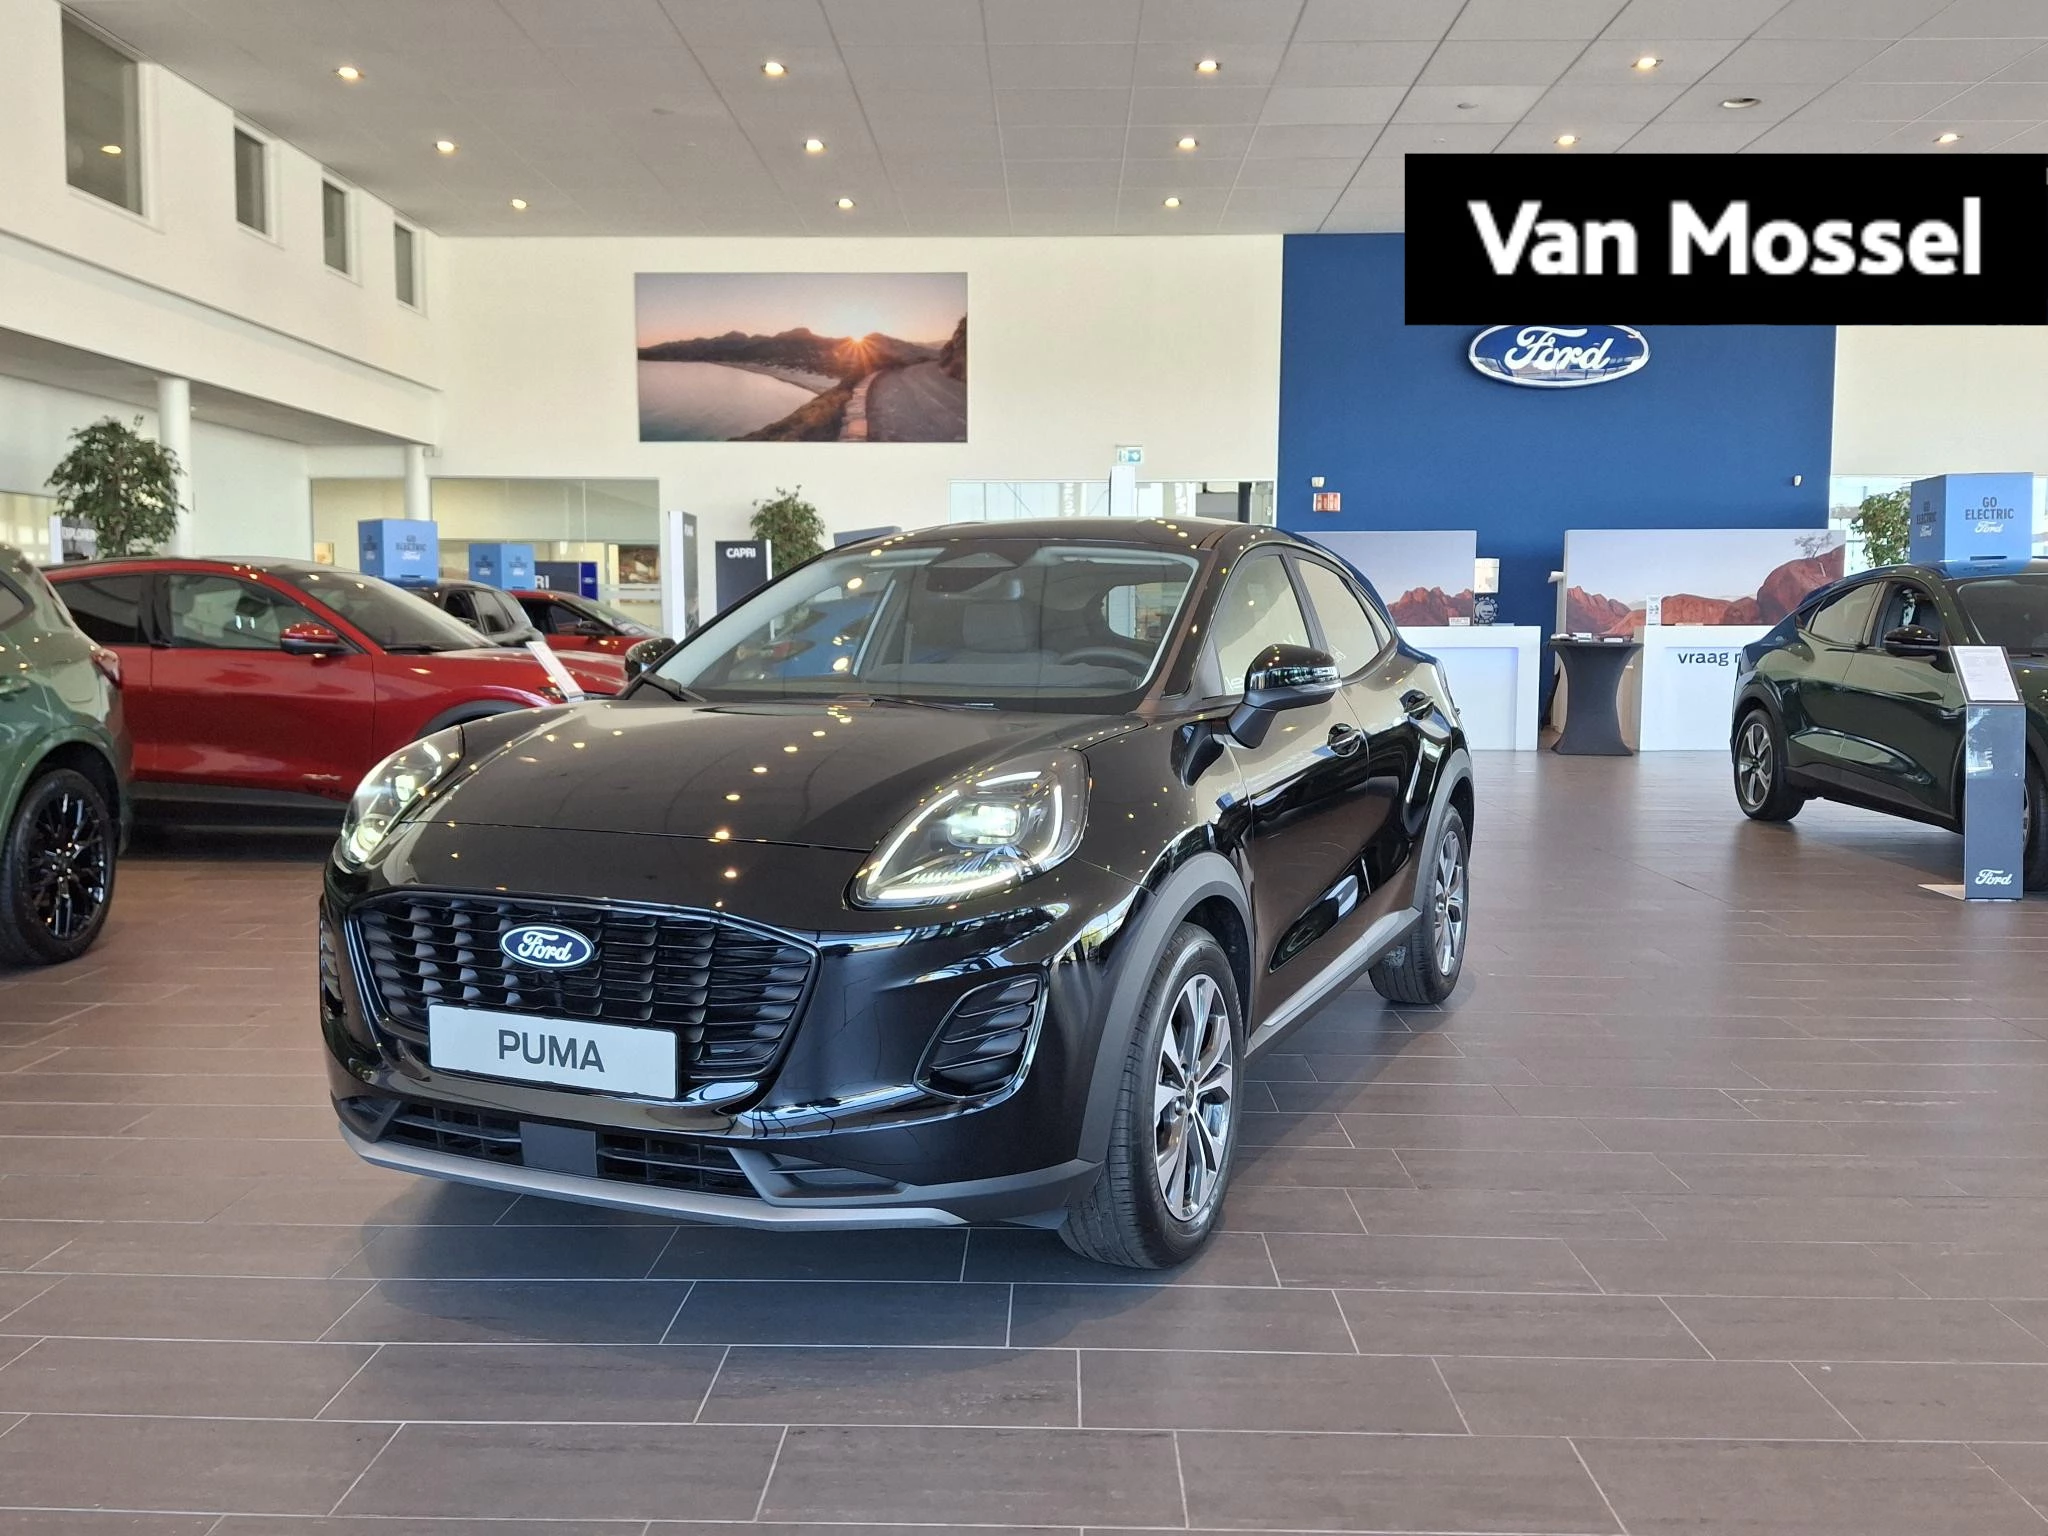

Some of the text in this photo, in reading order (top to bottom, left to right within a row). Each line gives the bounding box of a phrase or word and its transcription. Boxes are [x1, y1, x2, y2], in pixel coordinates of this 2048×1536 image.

[1504, 326, 1615, 371] Ford
[1982, 496, 1998, 508] GO
[1964, 508, 2015, 520] ELECTRIC
[1974, 520, 2004, 534] Ford
[725, 547, 757, 559] CAPRI
[1677, 651, 1729, 667] vraag
[1975, 868, 2012, 886] Ford
[517, 930, 573, 962] Ford
[498, 1029, 605, 1073] PUMA
